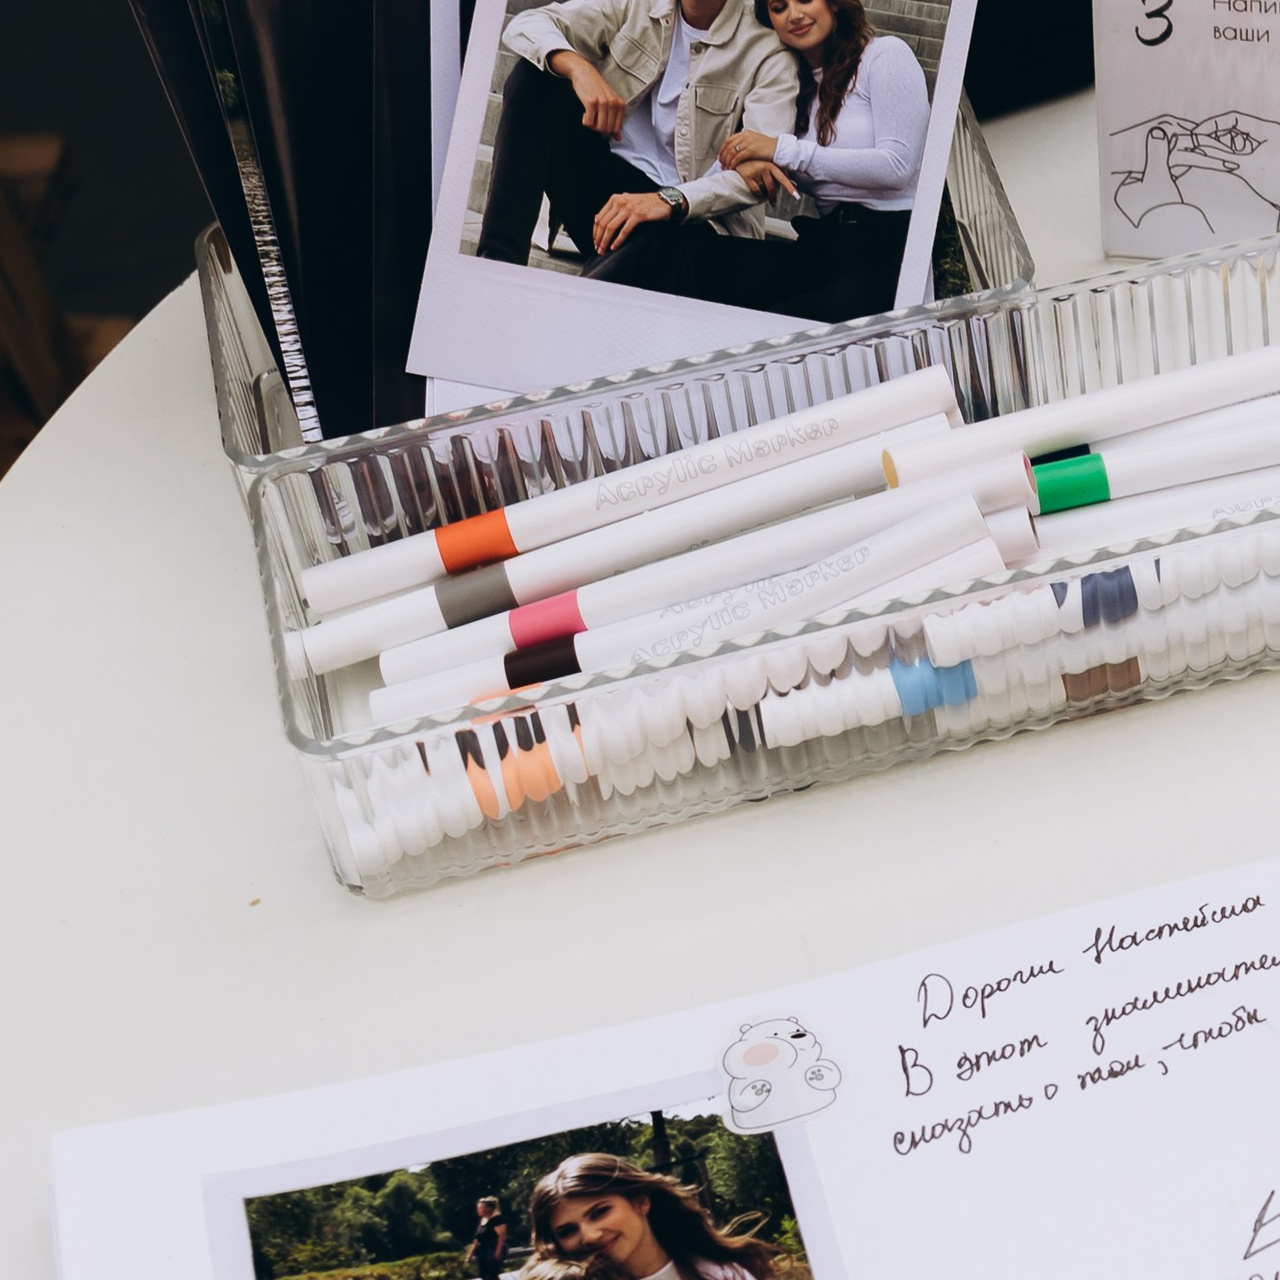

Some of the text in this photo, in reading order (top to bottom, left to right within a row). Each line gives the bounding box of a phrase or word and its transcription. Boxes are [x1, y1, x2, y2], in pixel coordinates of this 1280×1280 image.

[1213, 25, 1270, 44] ваши
[596, 418, 839, 510] Acrylic Marker
[758, 545, 870, 610] Marker
[898, 1042, 934, 1098] В
[956, 1034, 1048, 1084] этот
[892, 1093, 1034, 1158] сказать
[1043, 1083, 1059, 1102] о
